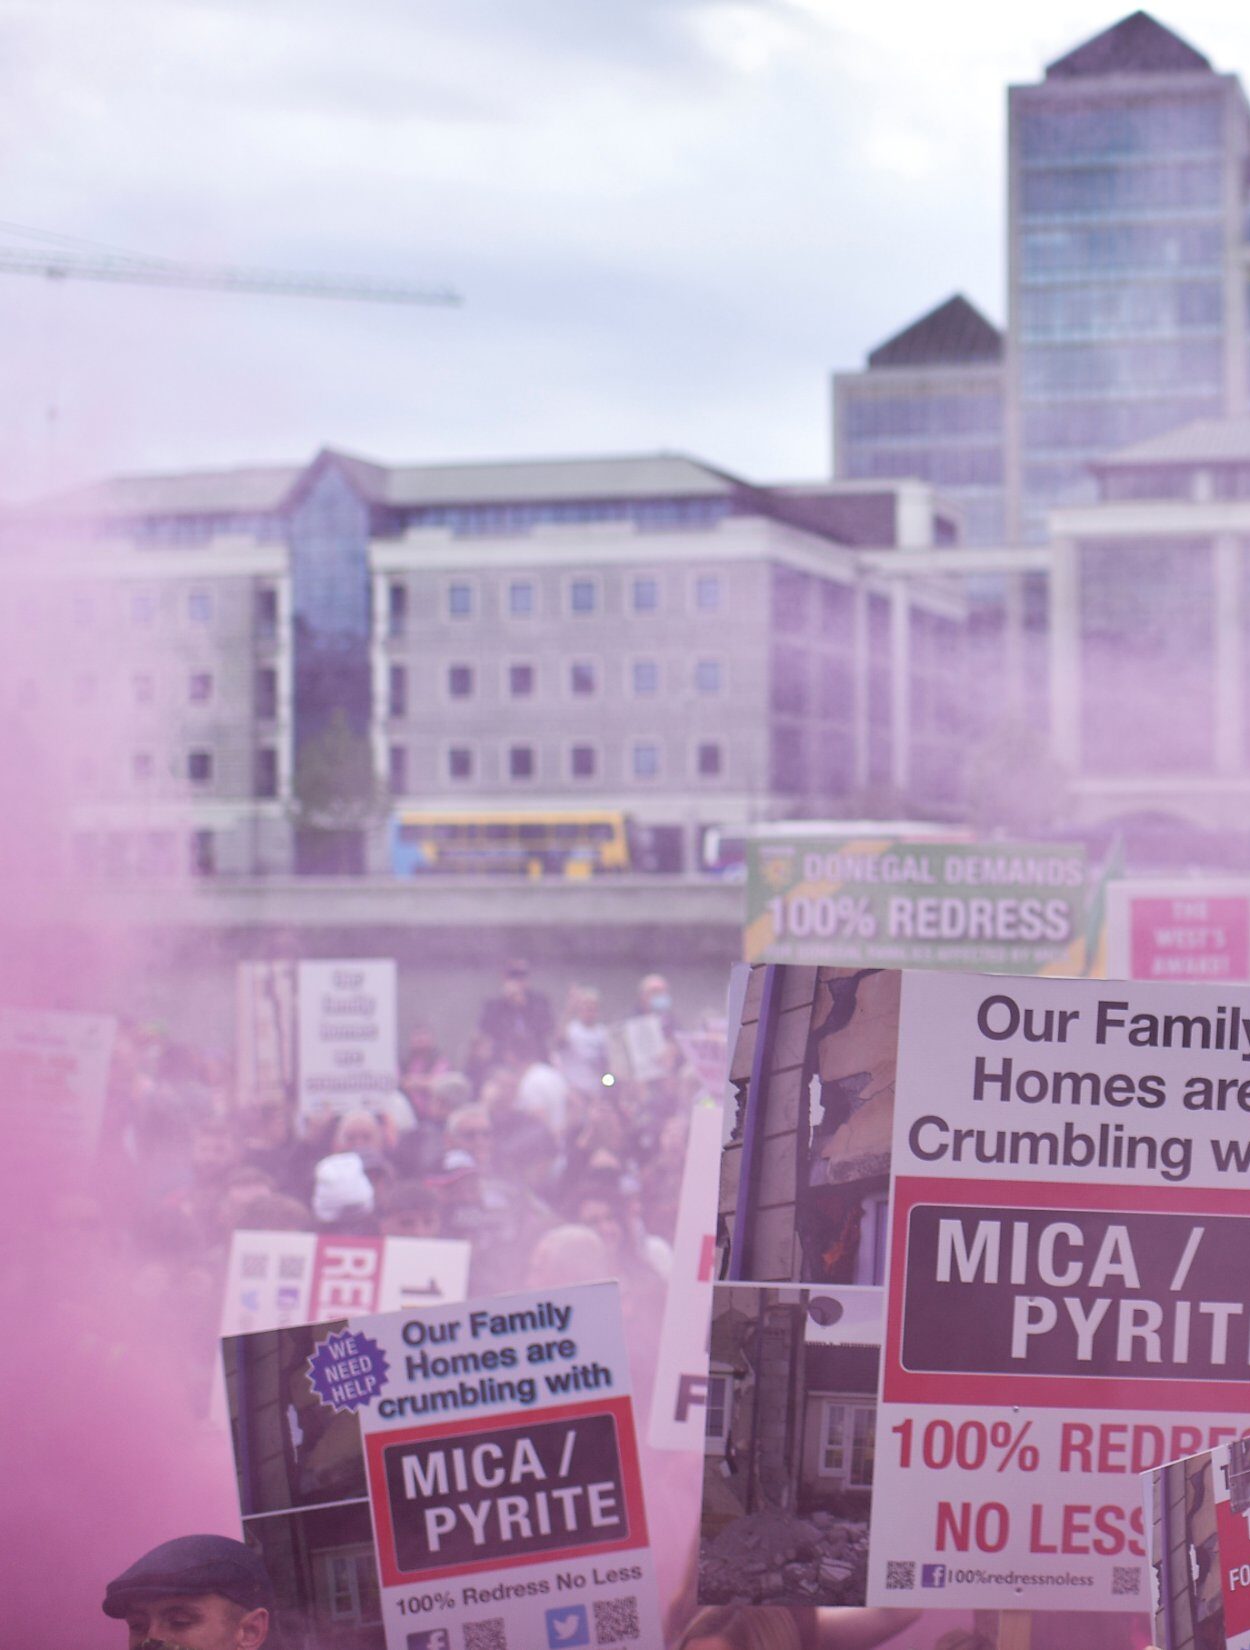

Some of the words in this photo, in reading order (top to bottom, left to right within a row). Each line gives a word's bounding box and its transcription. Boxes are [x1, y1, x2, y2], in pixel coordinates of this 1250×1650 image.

[803, 853, 936, 885] DONEGAL
[945, 856, 1084, 888] DEMANDS
[770, 895, 878, 938] 100%
[889, 897, 1070, 941] REDRESS
[977, 994, 1080, 1042] Our
[973, 1056, 1167, 1108] Homes
[908, 1115, 1193, 1182] Crumbling
[936, 1219, 1141, 1289] MICA
[1170, 1226, 1205, 1291] /
[328, 1337, 358, 1362] WE
[402, 1319, 461, 1348] Our
[469, 1301, 573, 1340] Family
[324, 1355, 374, 1384] NEED
[405, 1346, 519, 1382] Homes
[527, 1337, 577, 1365] are
[331, 1374, 377, 1404] HELP
[377, 1375, 537, 1419] crumbling
[545, 1361, 613, 1395] with
[401, 1437, 548, 1501] MICA
[558, 1429, 577, 1479] /
[892, 1418, 1040, 1474] 100%
[424, 1481, 621, 1552] PYRITE
[934, 1501, 1009, 1553] NO
[396, 1591, 457, 1617] 100%
[462, 1578, 551, 1607] Redress
[556, 1573, 587, 1592] No
[591, 1564, 643, 1586] Less
[948, 1568, 1095, 1588] 100%redressnoless
